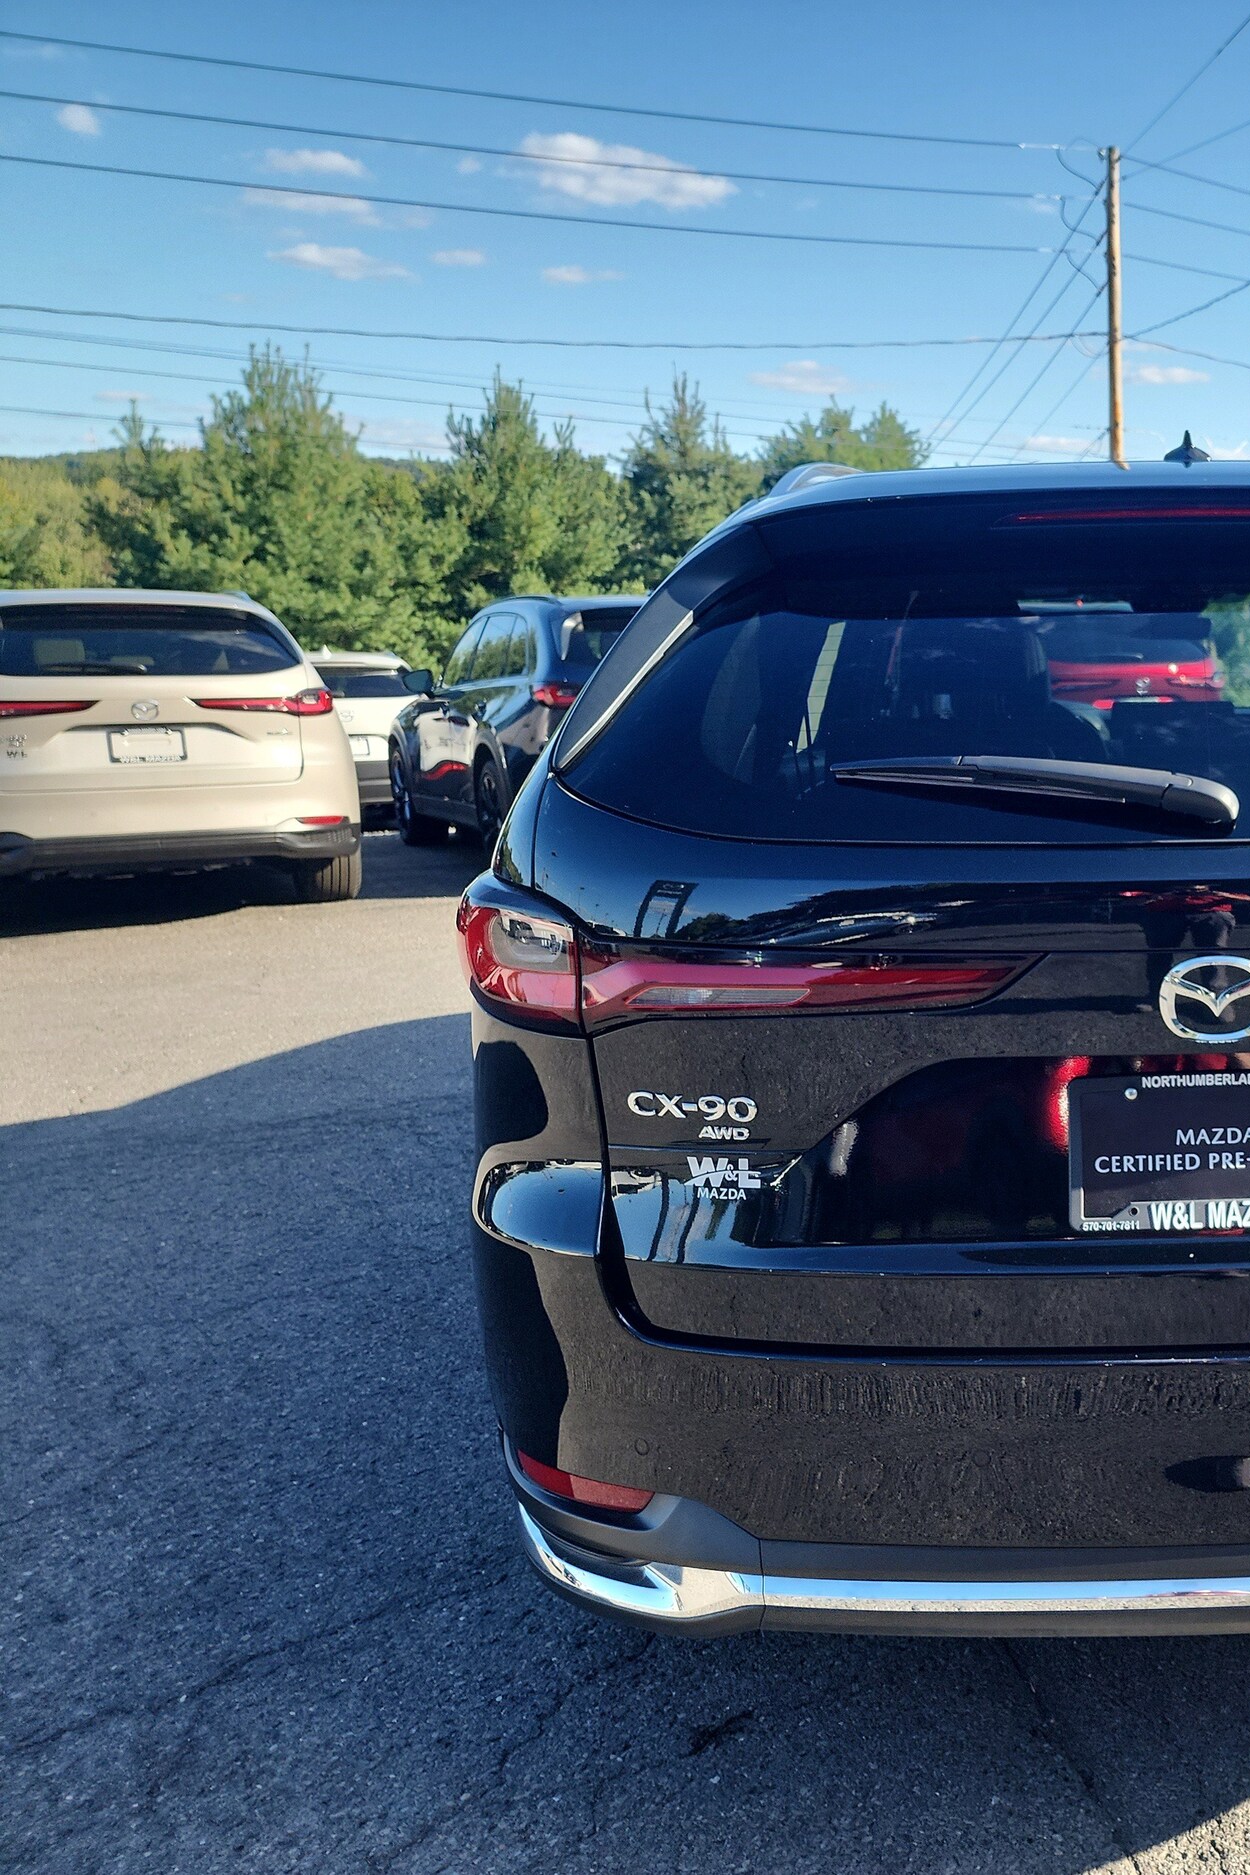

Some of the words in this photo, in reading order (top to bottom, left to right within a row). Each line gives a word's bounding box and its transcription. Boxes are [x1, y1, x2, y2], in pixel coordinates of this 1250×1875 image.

[627, 1090, 758, 1122] CX-90
[698, 1126, 750, 1140] AWD
[685, 1156, 761, 1188] W&L
[1094, 1152, 1200, 1174] CERTIFIED
[697, 1188, 747, 1200] MAZDA
[1150, 1201, 1203, 1231] W&L
